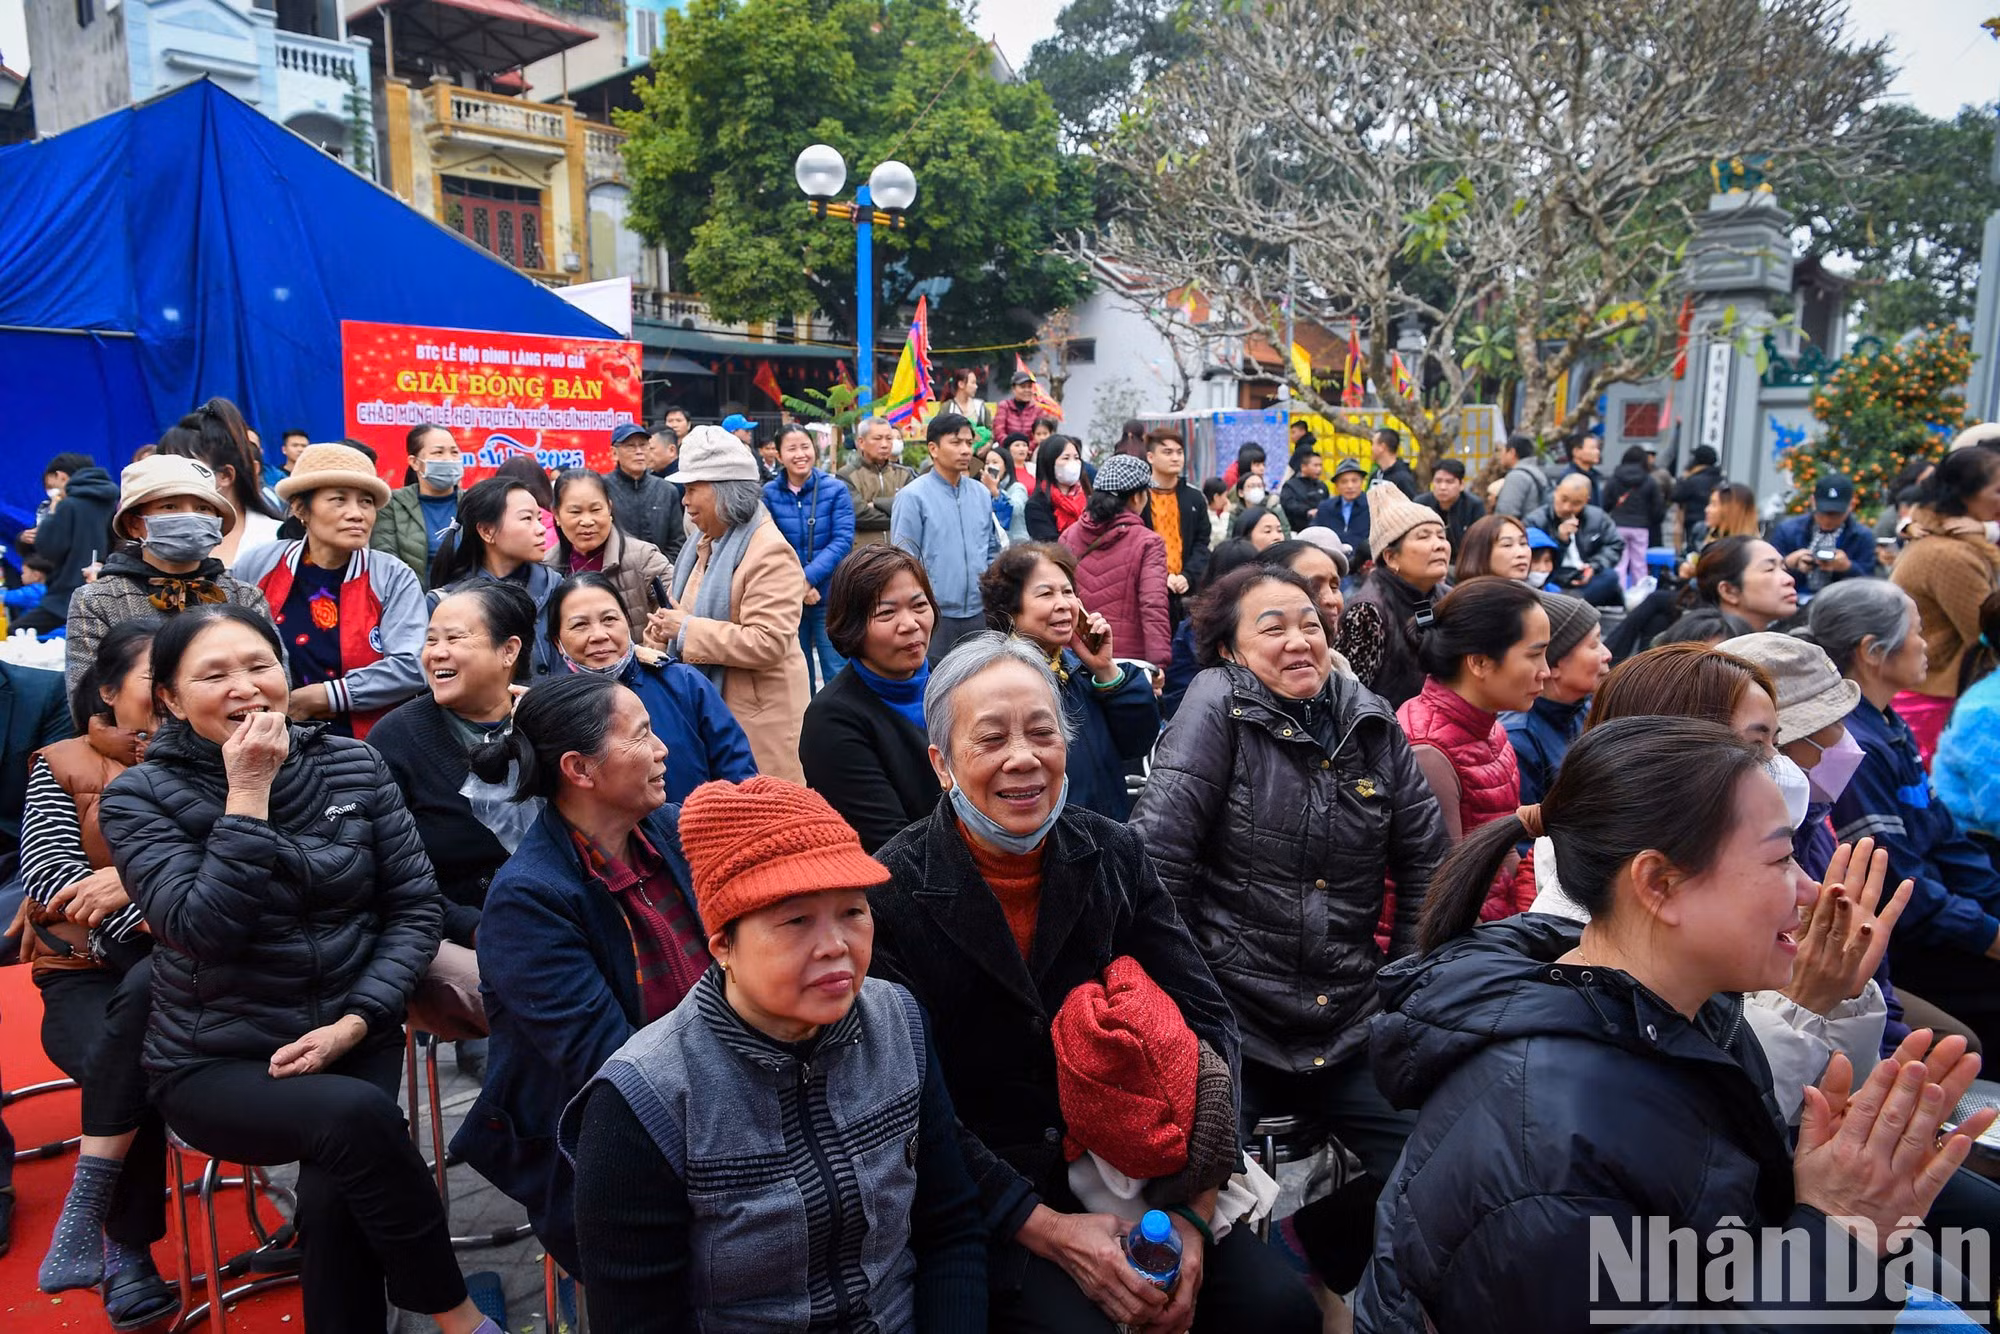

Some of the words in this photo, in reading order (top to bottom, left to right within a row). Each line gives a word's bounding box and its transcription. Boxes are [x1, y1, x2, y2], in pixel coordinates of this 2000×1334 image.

[416, 344, 440, 361] BTC
[459, 345, 480, 366] HỘI
[511, 348, 541, 367] LÀNG
[397, 365, 458, 394] GIẢI
[468, 371, 544, 398] BÓNG
[551, 375, 603, 400] BÀN
[357, 400, 396, 425] CHÀO
[478, 402, 523, 430] TRUYỀN
[524, 404, 562, 430] THỐNG
[563, 407, 591, 430] ĐÌNH
[536, 449, 585, 468] 2025
